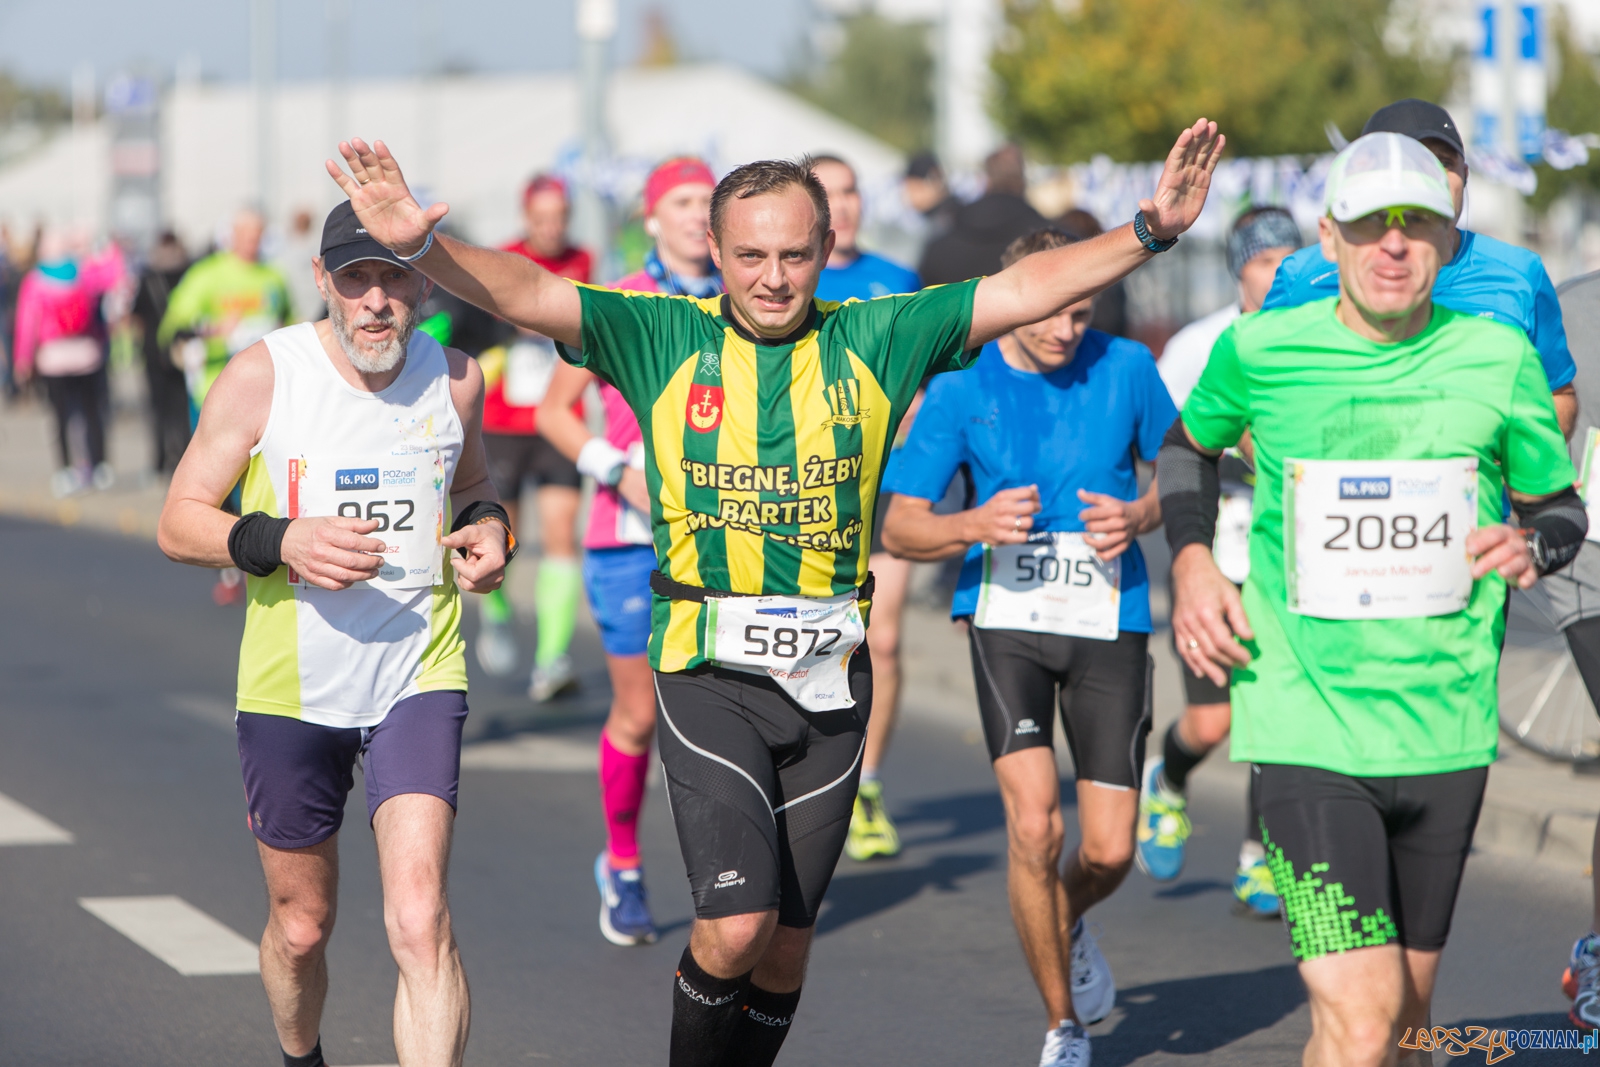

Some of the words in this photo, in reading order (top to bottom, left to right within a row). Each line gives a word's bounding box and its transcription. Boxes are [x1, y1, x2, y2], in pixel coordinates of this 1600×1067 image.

[354, 474, 376, 485] PKO
[382, 477, 416, 485] maraton
[803, 453, 863, 490] ŻEBY
[1361, 480, 1390, 496] PKO
[720, 495, 832, 526] BARTEK
[1323, 511, 1453, 551] 2084
[1016, 555, 1093, 587] 5015
[744, 624, 842, 659] 5872
[768, 667, 810, 682] Krzysztof
[678, 976, 711, 1004] ROYAL
[748, 1008, 787, 1024] ROYAL
